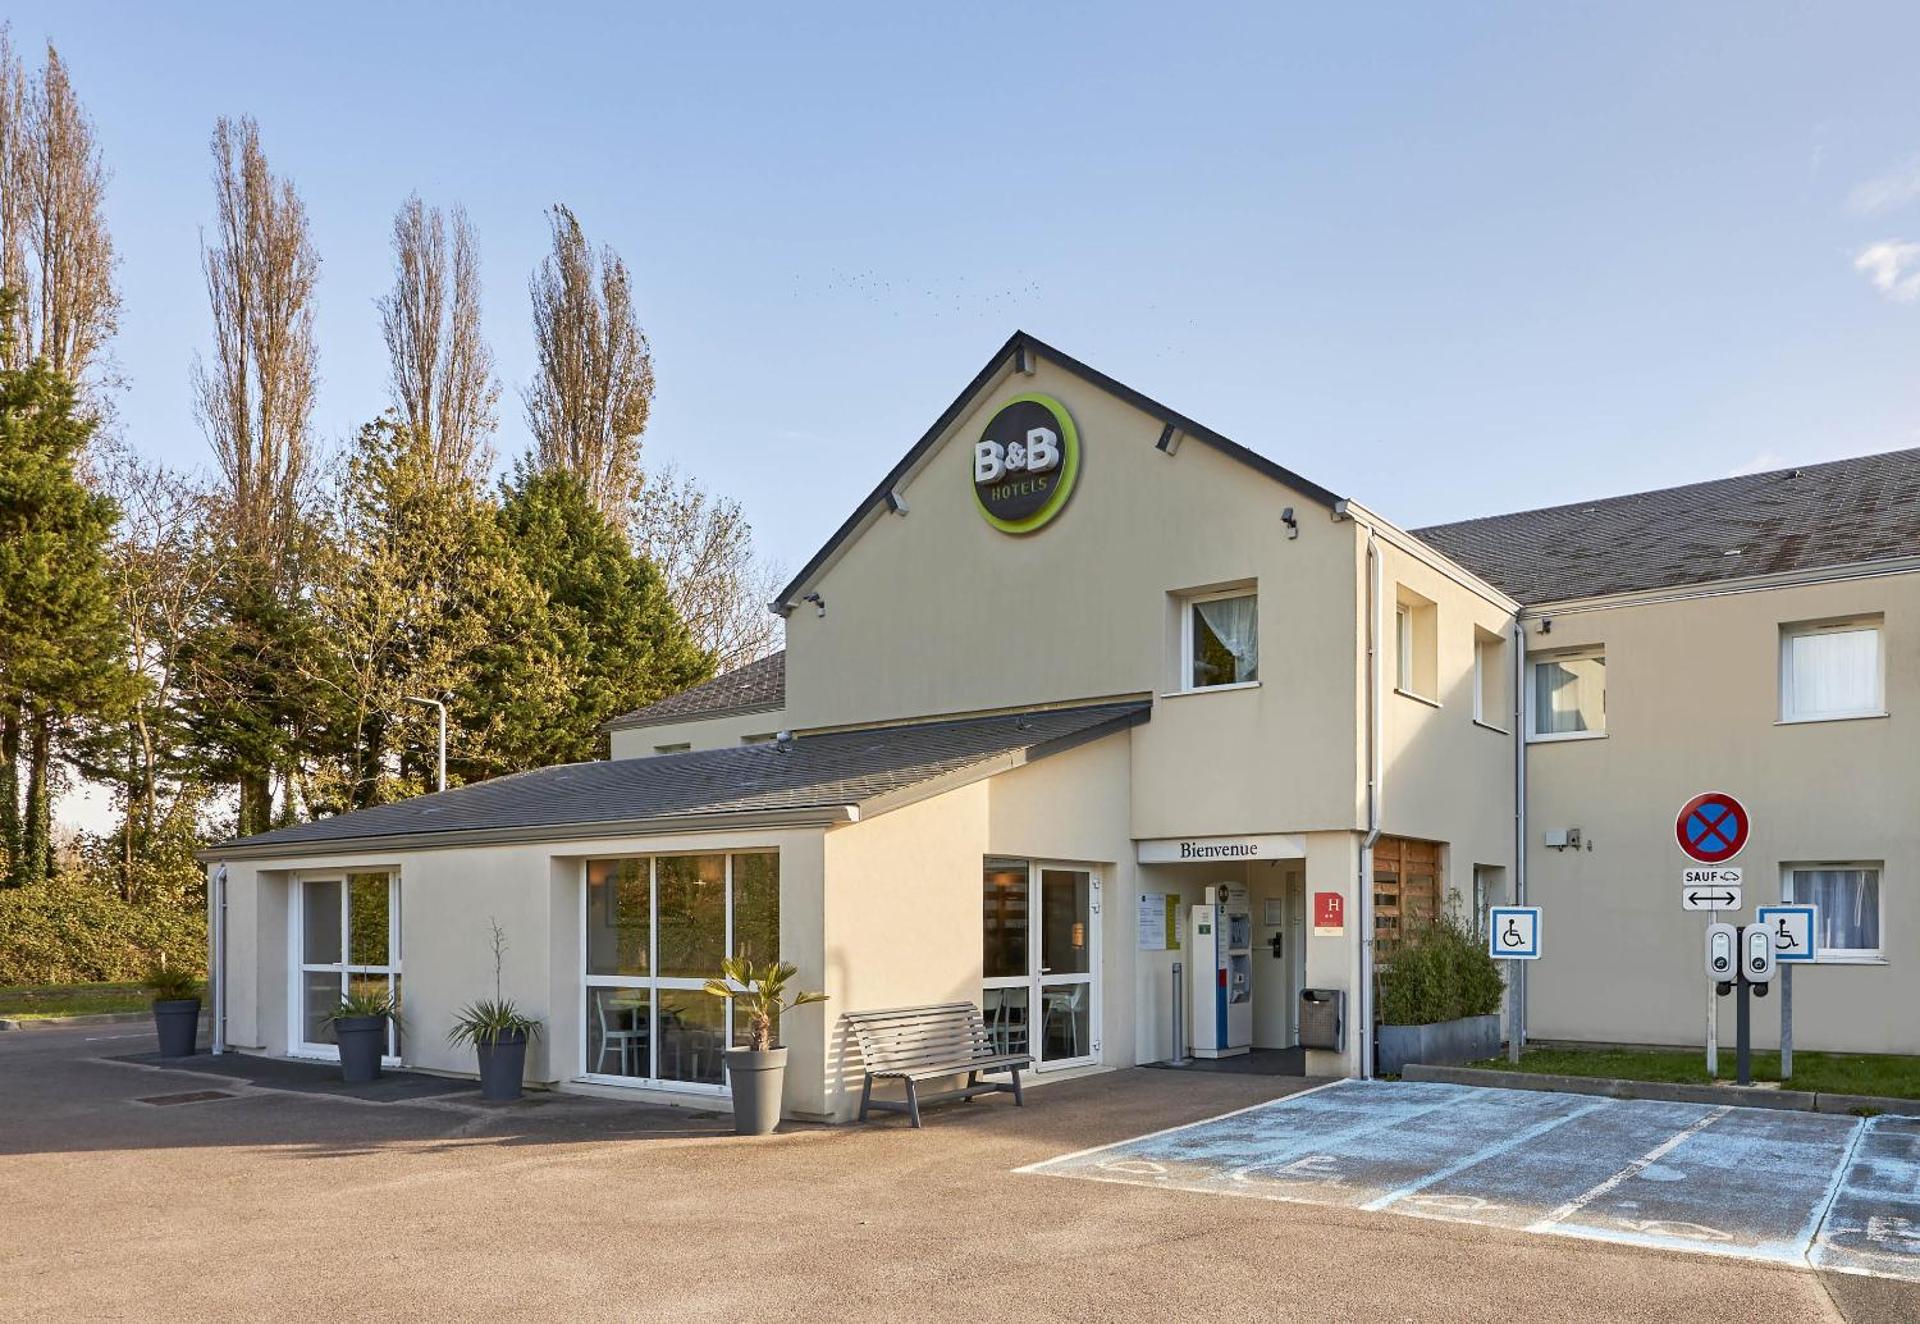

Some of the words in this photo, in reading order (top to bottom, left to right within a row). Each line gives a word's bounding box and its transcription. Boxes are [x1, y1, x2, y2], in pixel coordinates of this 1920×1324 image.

[975, 427, 1059, 484] B&B
[991, 477, 1047, 500] HOTELS
[1180, 842, 1258, 858] Bienvenue
[1686, 871, 1718, 881] SAUF
[1329, 898, 1339, 911] H
